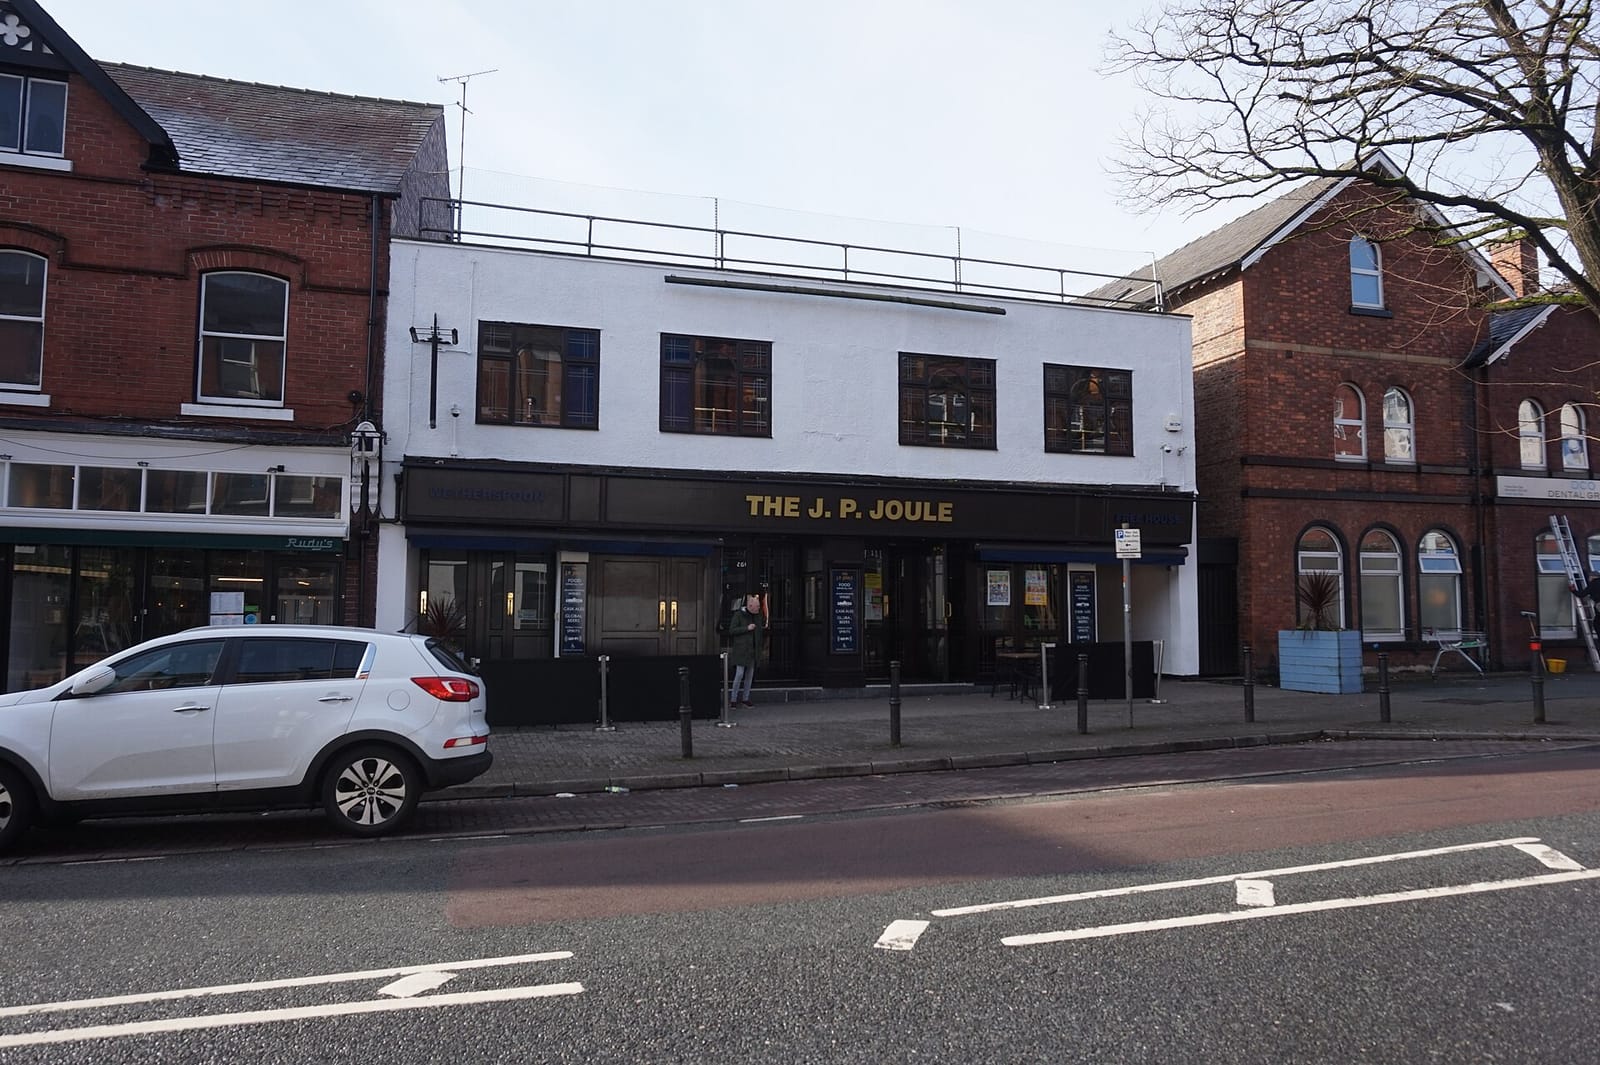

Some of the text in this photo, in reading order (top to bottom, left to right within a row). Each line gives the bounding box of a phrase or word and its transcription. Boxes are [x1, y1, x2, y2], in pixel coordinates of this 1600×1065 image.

[1547, 490, 1585, 499] DENTAL
[746, 495, 953, 522] THE J. P. JOULE
[285, 538, 333, 551] Rudy's
